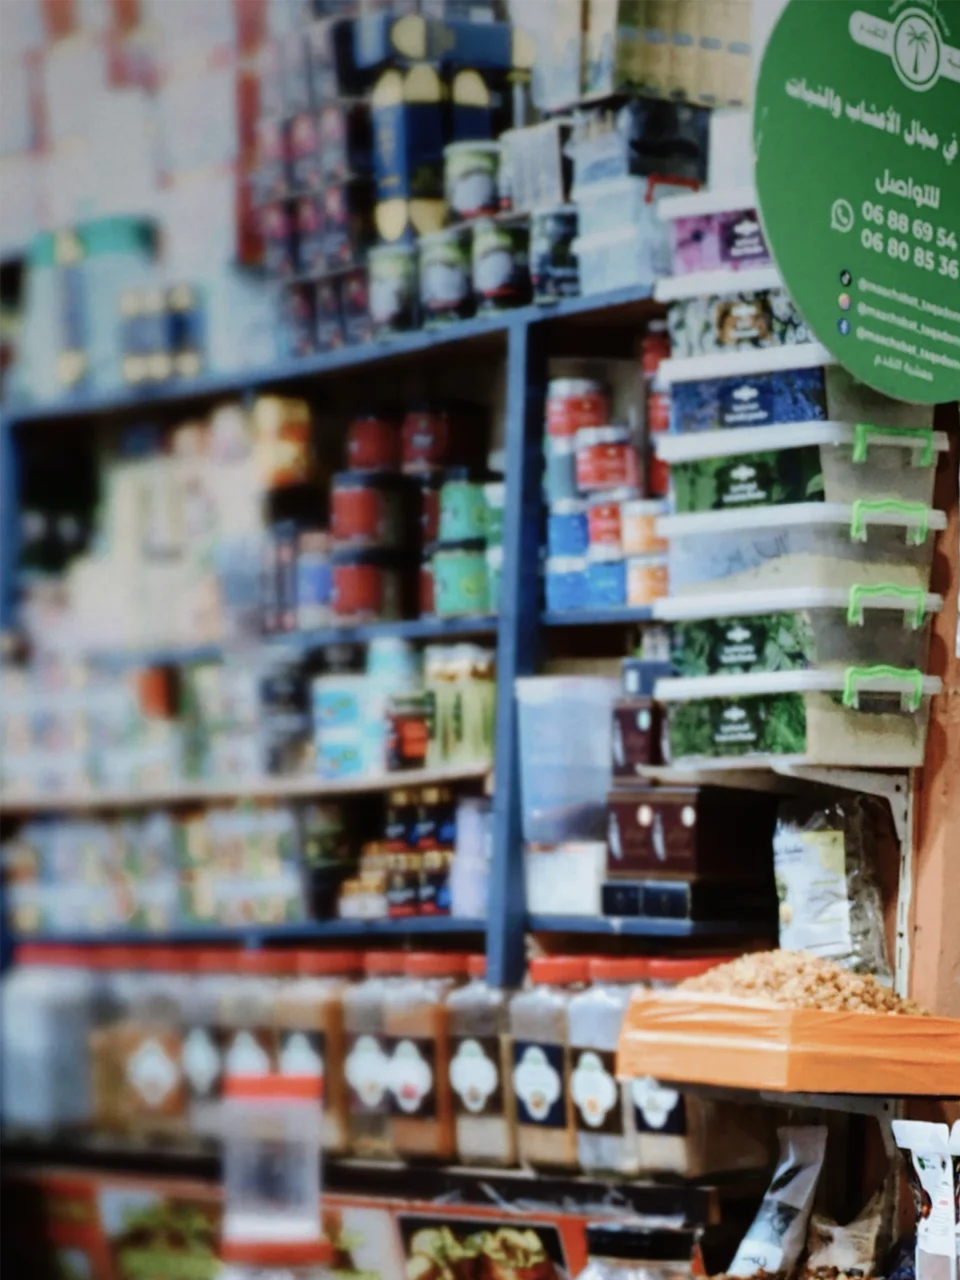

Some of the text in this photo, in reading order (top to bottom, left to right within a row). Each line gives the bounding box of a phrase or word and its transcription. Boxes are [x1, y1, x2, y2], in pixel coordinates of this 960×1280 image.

[845, 99, 901, 135] الأعشاب
[904, 118, 939, 150] مجال
[942, 132, 959, 166] في
[875, 169, 940, 209] للتواصل
[861, 200, 884, 225] 06
[887, 209, 909, 234] 88
[912, 220, 933, 243] 69
[936, 228, 957, 251] 54
[861, 229, 883, 253] 06
[887, 238, 909, 262] 80
[913, 247, 935, 271] 85
[937, 256, 959, 279] 36
